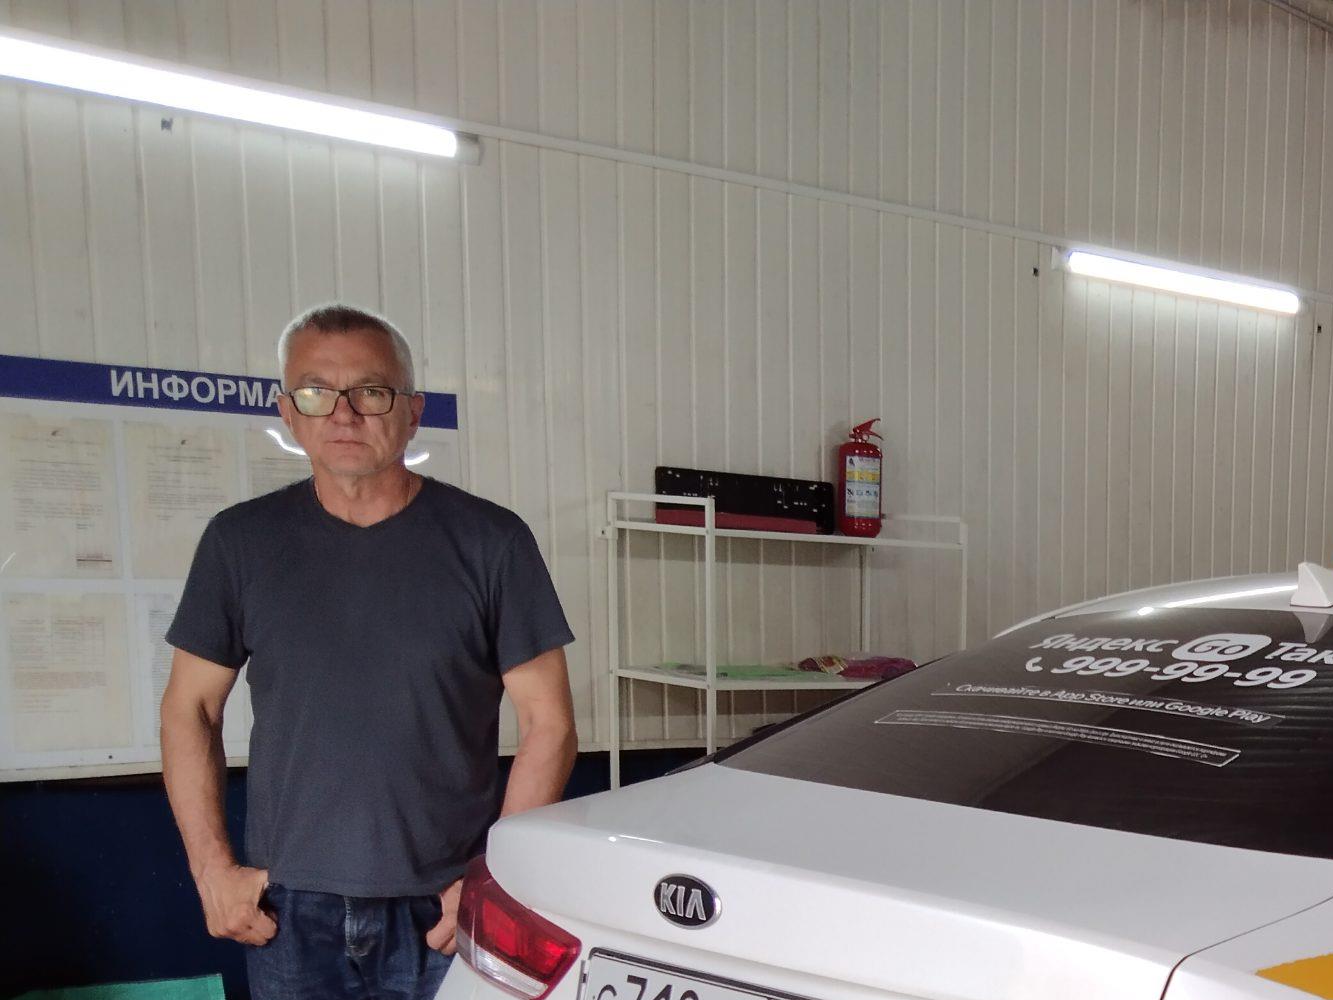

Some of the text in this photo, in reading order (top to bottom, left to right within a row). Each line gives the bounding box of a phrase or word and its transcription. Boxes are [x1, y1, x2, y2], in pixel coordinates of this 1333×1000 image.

[1028, 633, 1179, 653] Яндекс
[1050, 655, 1317, 689] 999-99-99
[1051, 690, 1085, 701] App
[1085, 693, 1129, 705] Store
[1129, 698, 1165, 709] или
[1164, 701, 1229, 717] Google
[1228, 708, 1271, 724] Play
[659, 881, 708, 921] KIA
